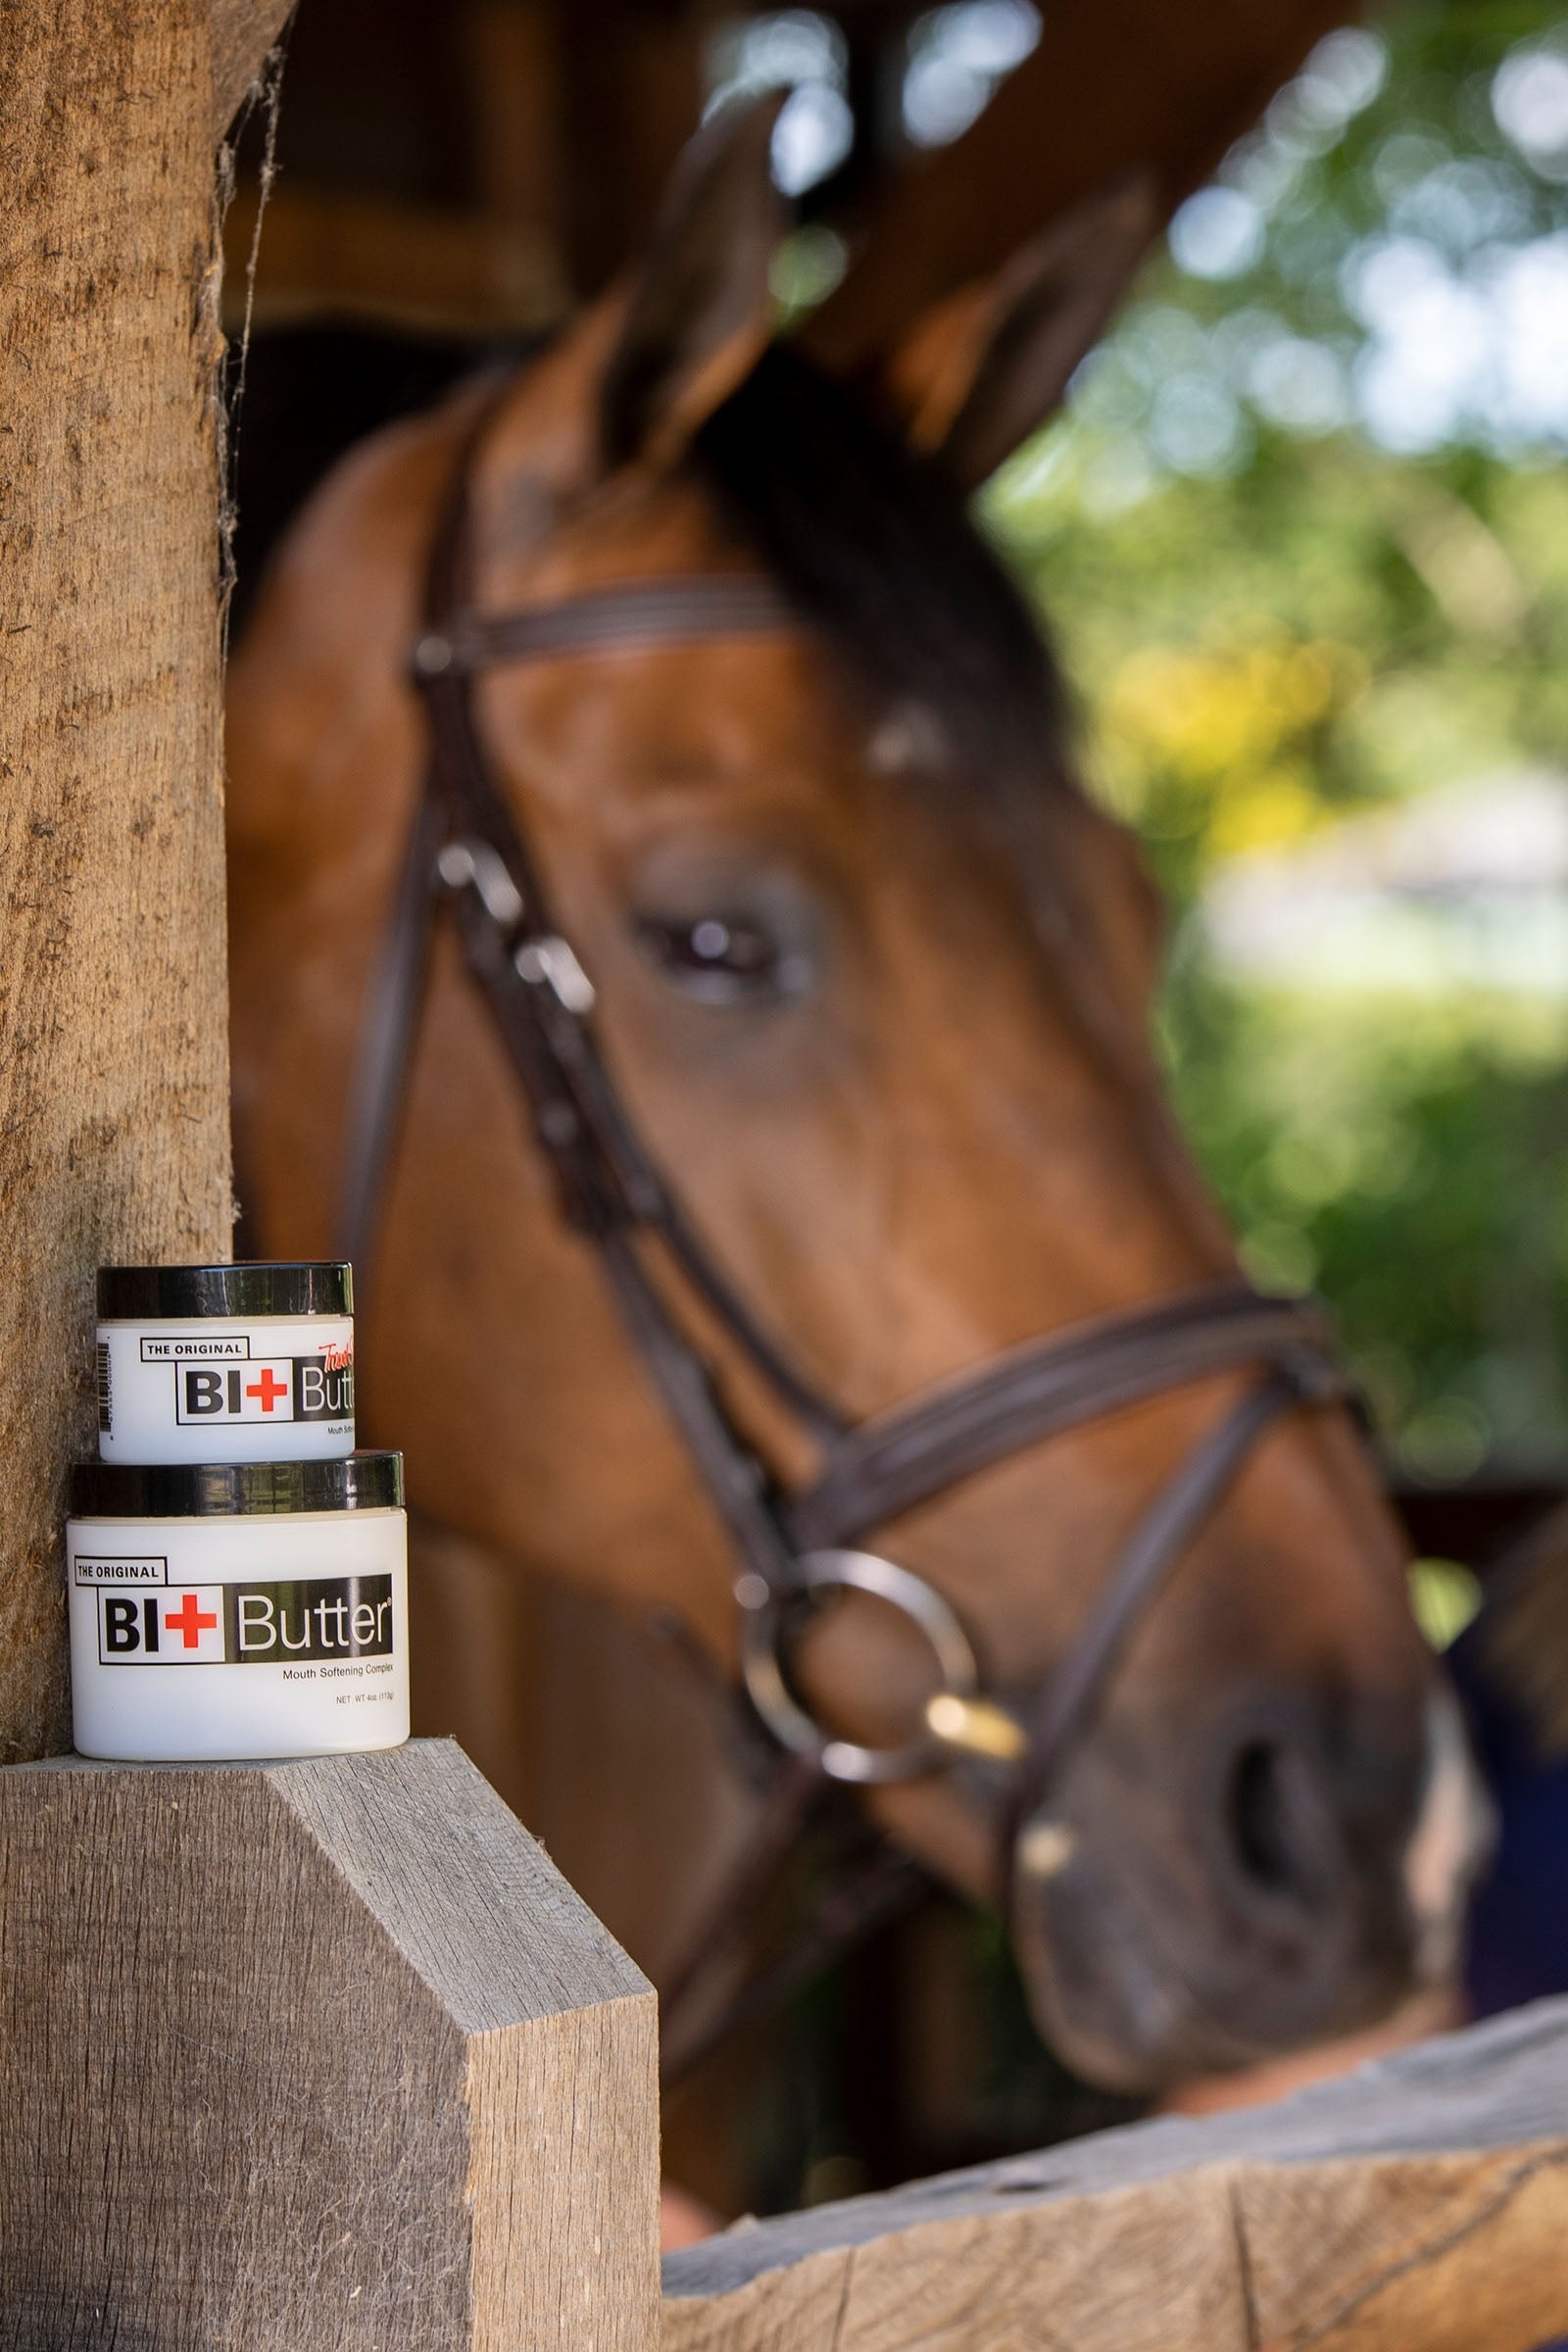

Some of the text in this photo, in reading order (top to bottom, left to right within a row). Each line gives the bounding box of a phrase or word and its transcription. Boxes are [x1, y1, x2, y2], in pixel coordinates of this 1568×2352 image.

[147, 1344, 242, 1354] THE ORIGINAL
[302, 1366, 354, 1412] Butt
[77, 1565, 159, 1578] THE ORIGINAL
[282, 1663, 393, 1680] Mouth Softening Complex
[336, 1695, 351, 1704] NET
[355, 1693, 366, 1702] WT
